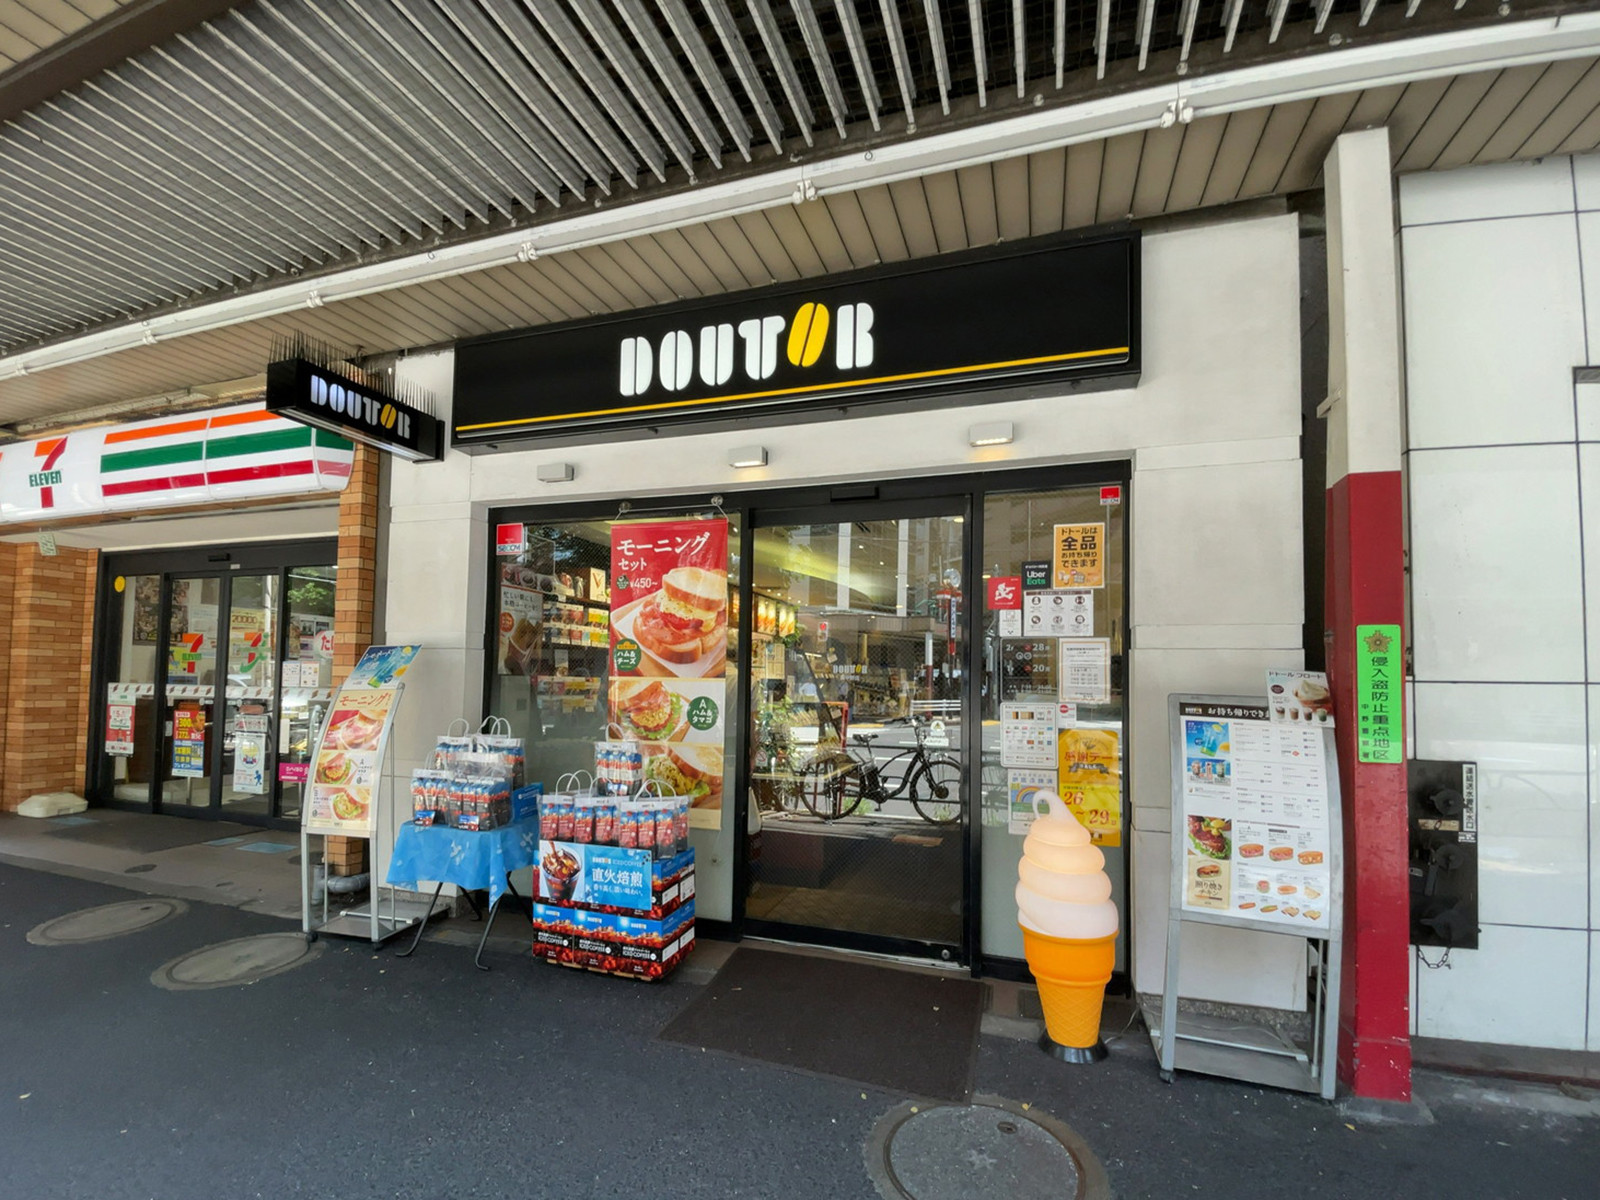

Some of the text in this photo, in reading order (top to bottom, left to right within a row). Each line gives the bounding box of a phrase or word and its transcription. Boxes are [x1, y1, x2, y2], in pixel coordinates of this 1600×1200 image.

[619, 302, 875, 397] DOUTOR
[310, 374, 411, 440] DOUTOR
[34, 436, 68, 509] 7
[1061, 527, 1098, 535] ドトールは
[617, 532, 711, 556] モーニング
[1061, 536, 1097, 551] 全品
[1061, 551, 1098, 559] お持ち帰り
[618, 557, 647, 572] セット
[1061, 559, 1098, 568] できます
[321, 635, 334, 651] た
[341, 692, 388, 706] モーニング
[700, 699, 707, 708] A
[1371, 656, 1390, 760] 侵入盗防止重点地区
[692, 715, 713, 724] タマゴ
[1064, 791, 1085, 805] 26
[592, 868, 643, 888] 直火焙煎
